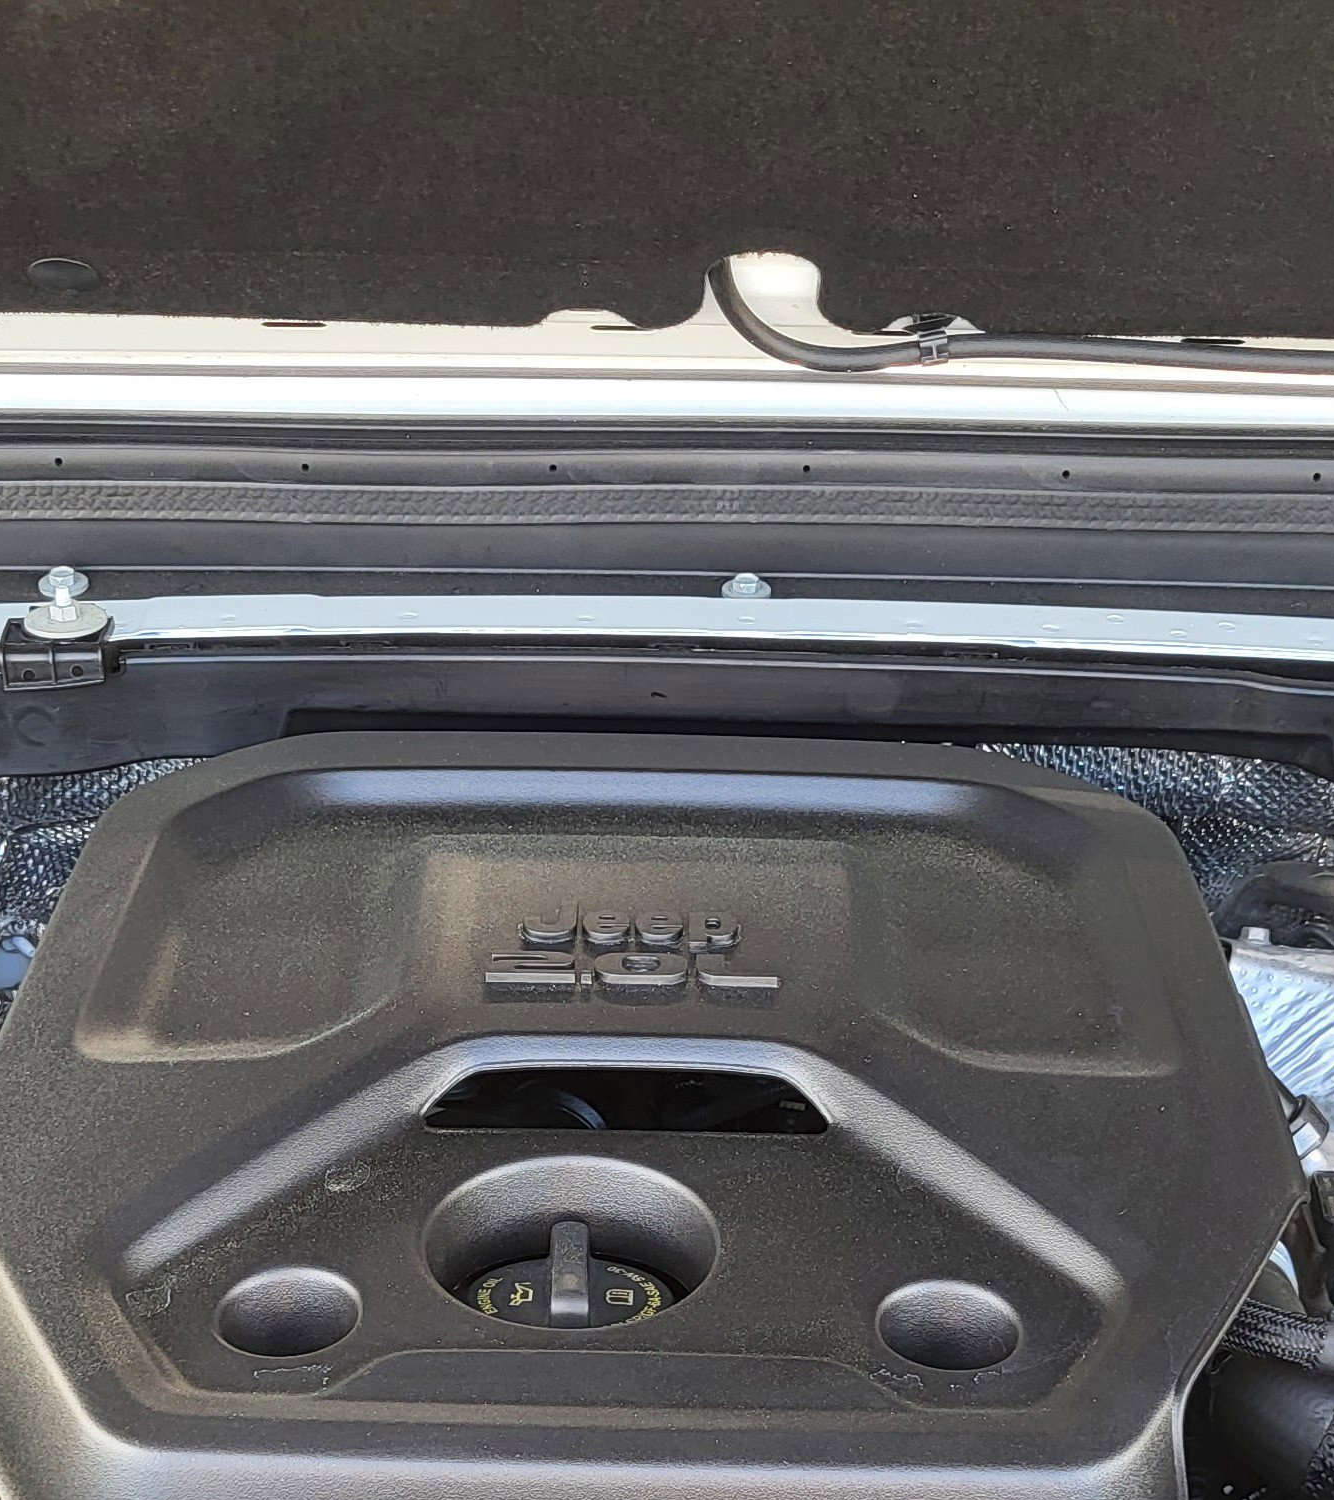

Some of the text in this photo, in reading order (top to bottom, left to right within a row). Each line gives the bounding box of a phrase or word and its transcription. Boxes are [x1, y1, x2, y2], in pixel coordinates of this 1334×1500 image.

[518, 901, 742, 953] Jeep
[484, 951, 781, 988] 2.0L
[477, 1288, 499, 1316] ENGINE
